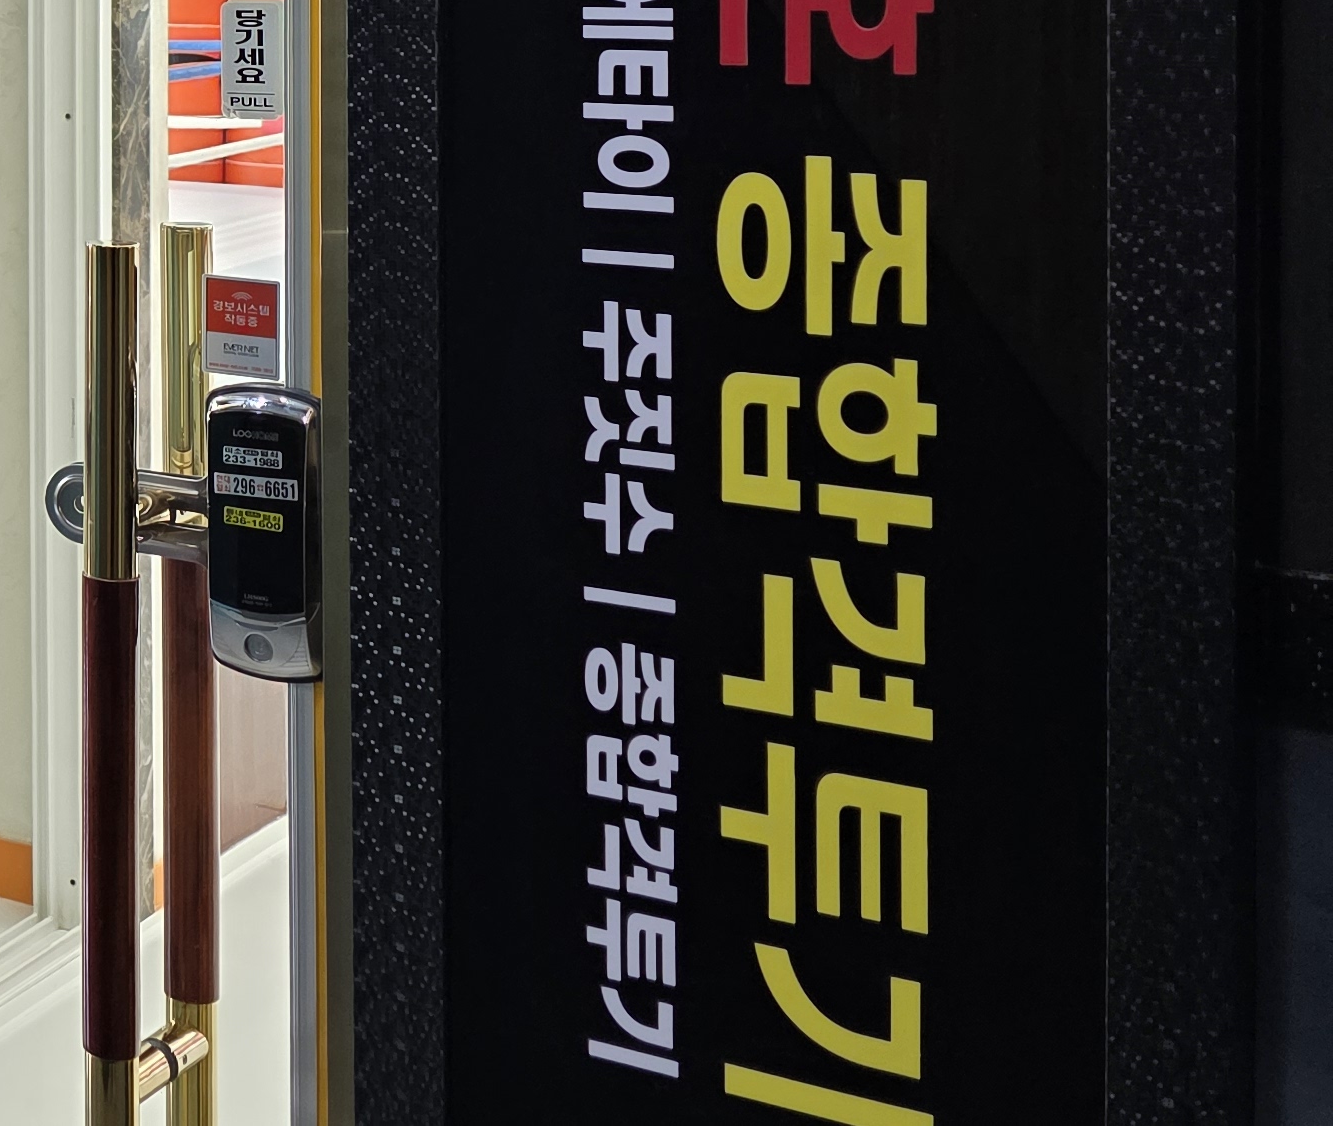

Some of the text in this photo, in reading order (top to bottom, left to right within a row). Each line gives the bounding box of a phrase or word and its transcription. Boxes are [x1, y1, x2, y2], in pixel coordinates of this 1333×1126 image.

[234, 9, 267, 85] 당기세요
[229, 96, 274, 108] PULL
[213, 300, 270, 317] 경보시스템
[224, 313, 258, 328] 작동중
[583, 301, 676, 555] 주짓수
[224, 454, 280, 468] 233-1988
[233, 476, 296, 500] 296 6651
[717, 155, 937, 1126] 종합격투기
[583, 642, 679, 1078] 종합격투기
